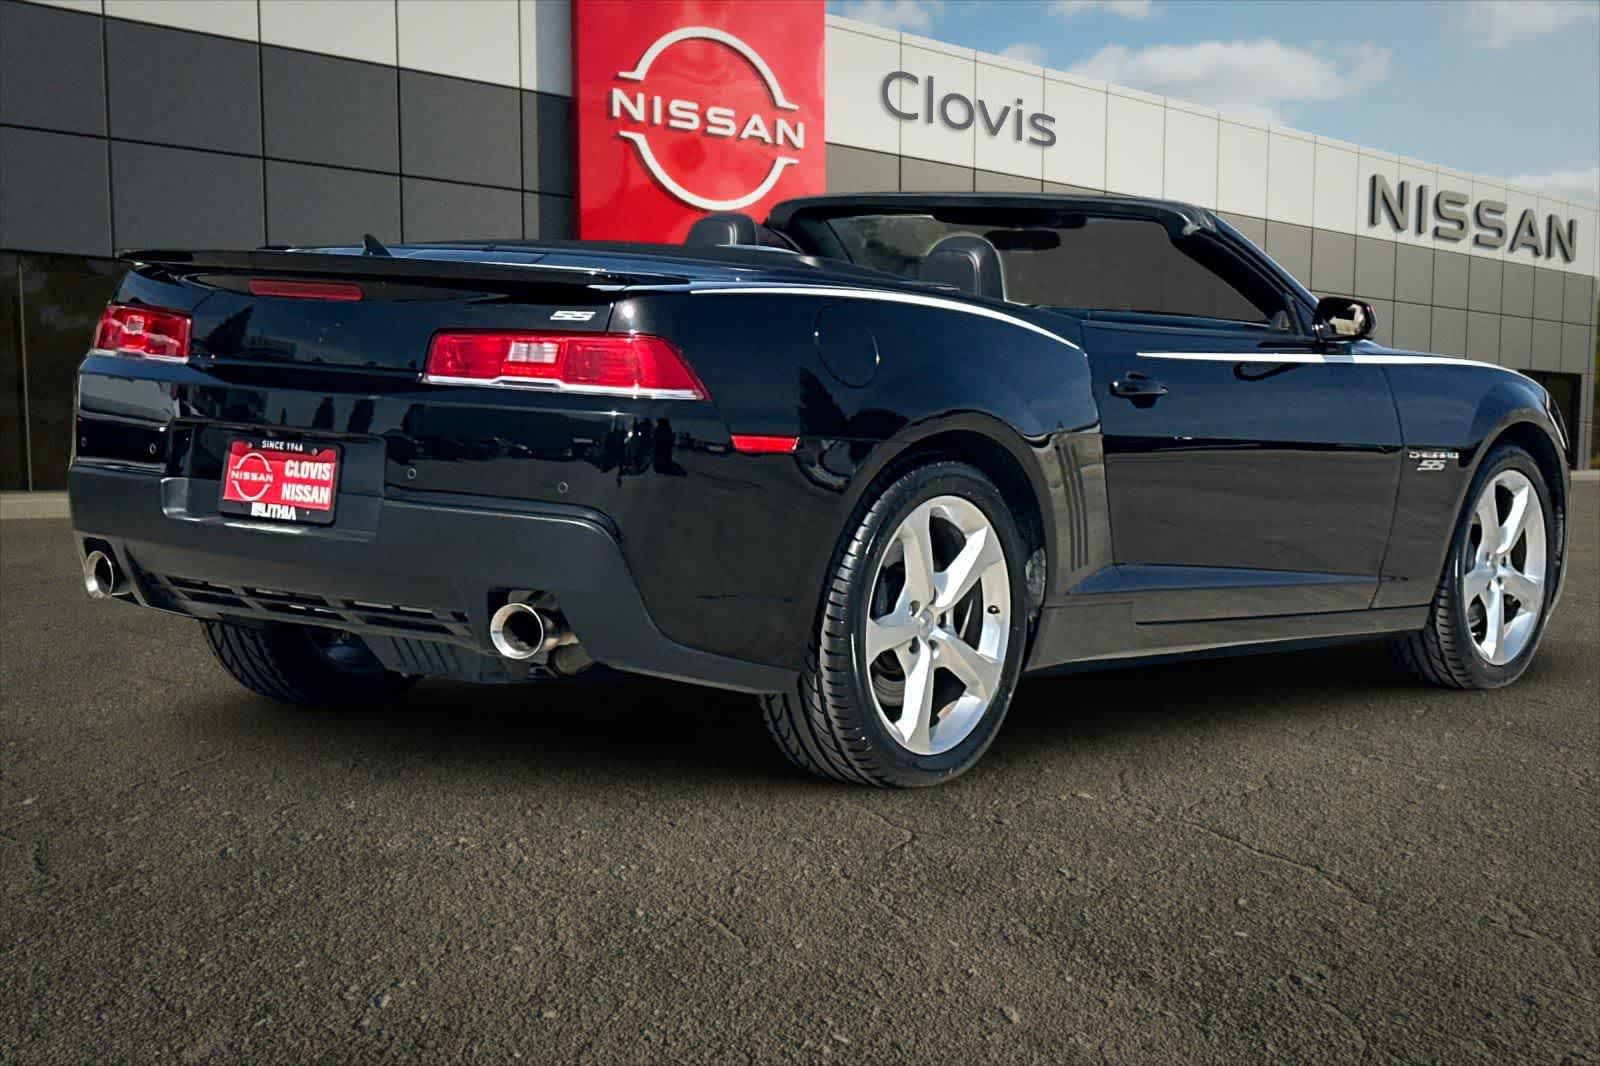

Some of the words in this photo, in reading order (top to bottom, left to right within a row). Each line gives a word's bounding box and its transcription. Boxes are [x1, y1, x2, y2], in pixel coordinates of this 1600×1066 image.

[609, 87, 805, 149] NISSAN
[881, 70, 1057, 147] Clovis
[1368, 173, 1577, 263] NISSAN
[550, 310, 596, 321] SS
[262, 440, 284, 450] SINCE
[231, 470, 273, 482] NISSAN
[284, 460, 332, 480] CLOVIS
[281, 483, 330, 504] NISSAN
